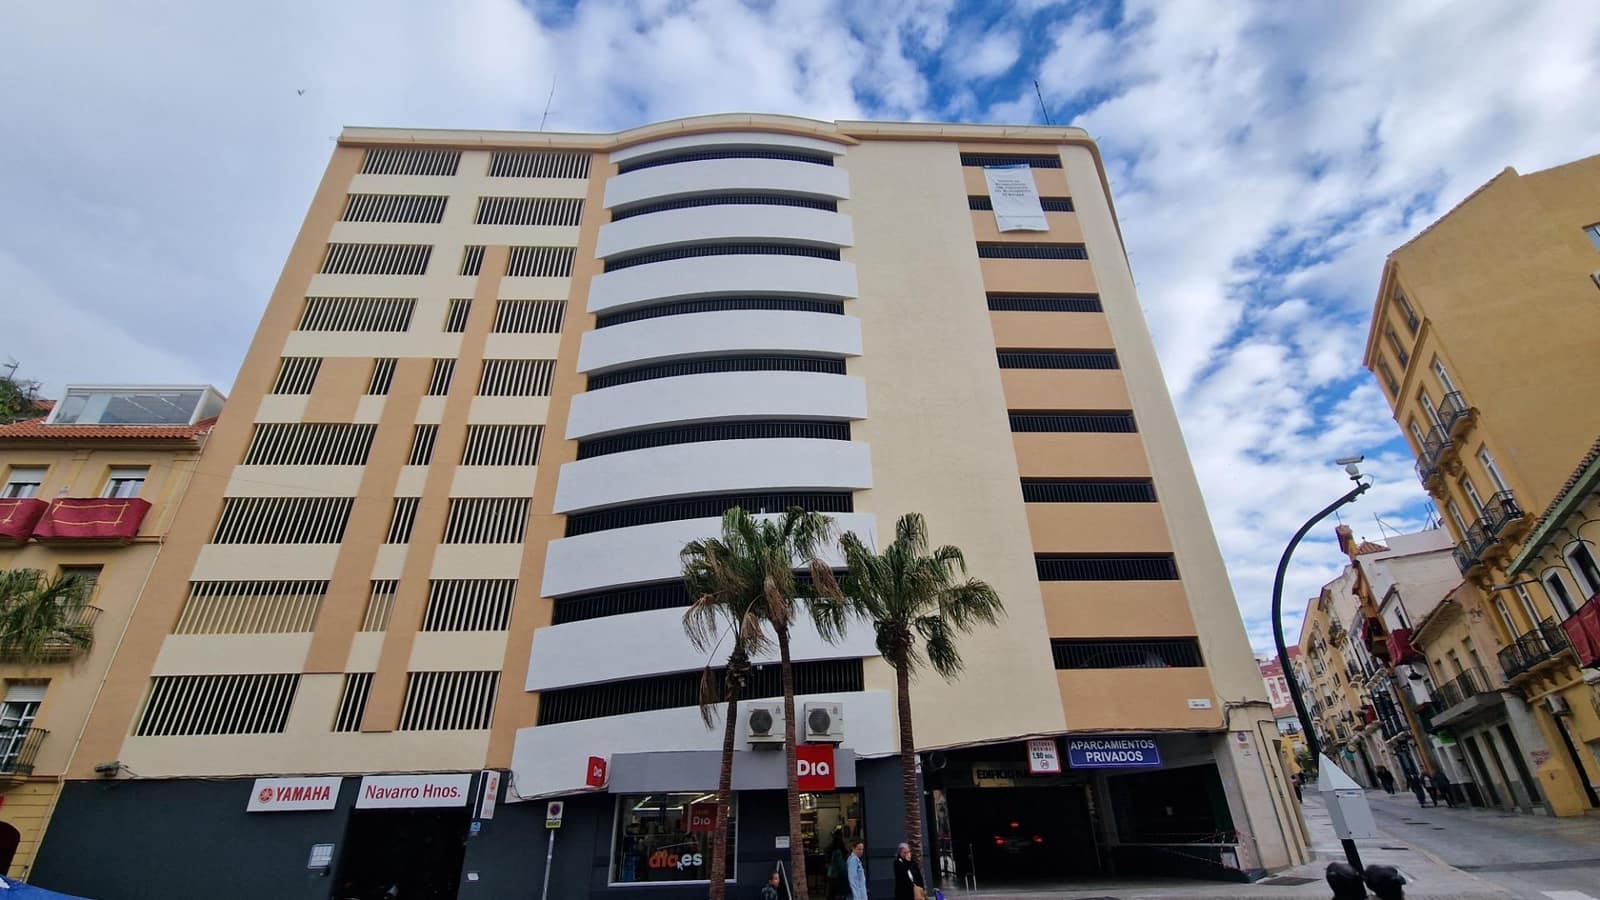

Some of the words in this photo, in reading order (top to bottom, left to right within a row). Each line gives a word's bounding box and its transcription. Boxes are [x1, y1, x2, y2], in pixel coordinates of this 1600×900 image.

[1070, 739, 1155, 750] APARCAMIENTOS
[1085, 751, 1144, 762] PRIVADOS
[276, 786, 331, 801] YAMAHA
[365, 785, 419, 799] Navarro
[423, 784, 461, 798] Hnos.
